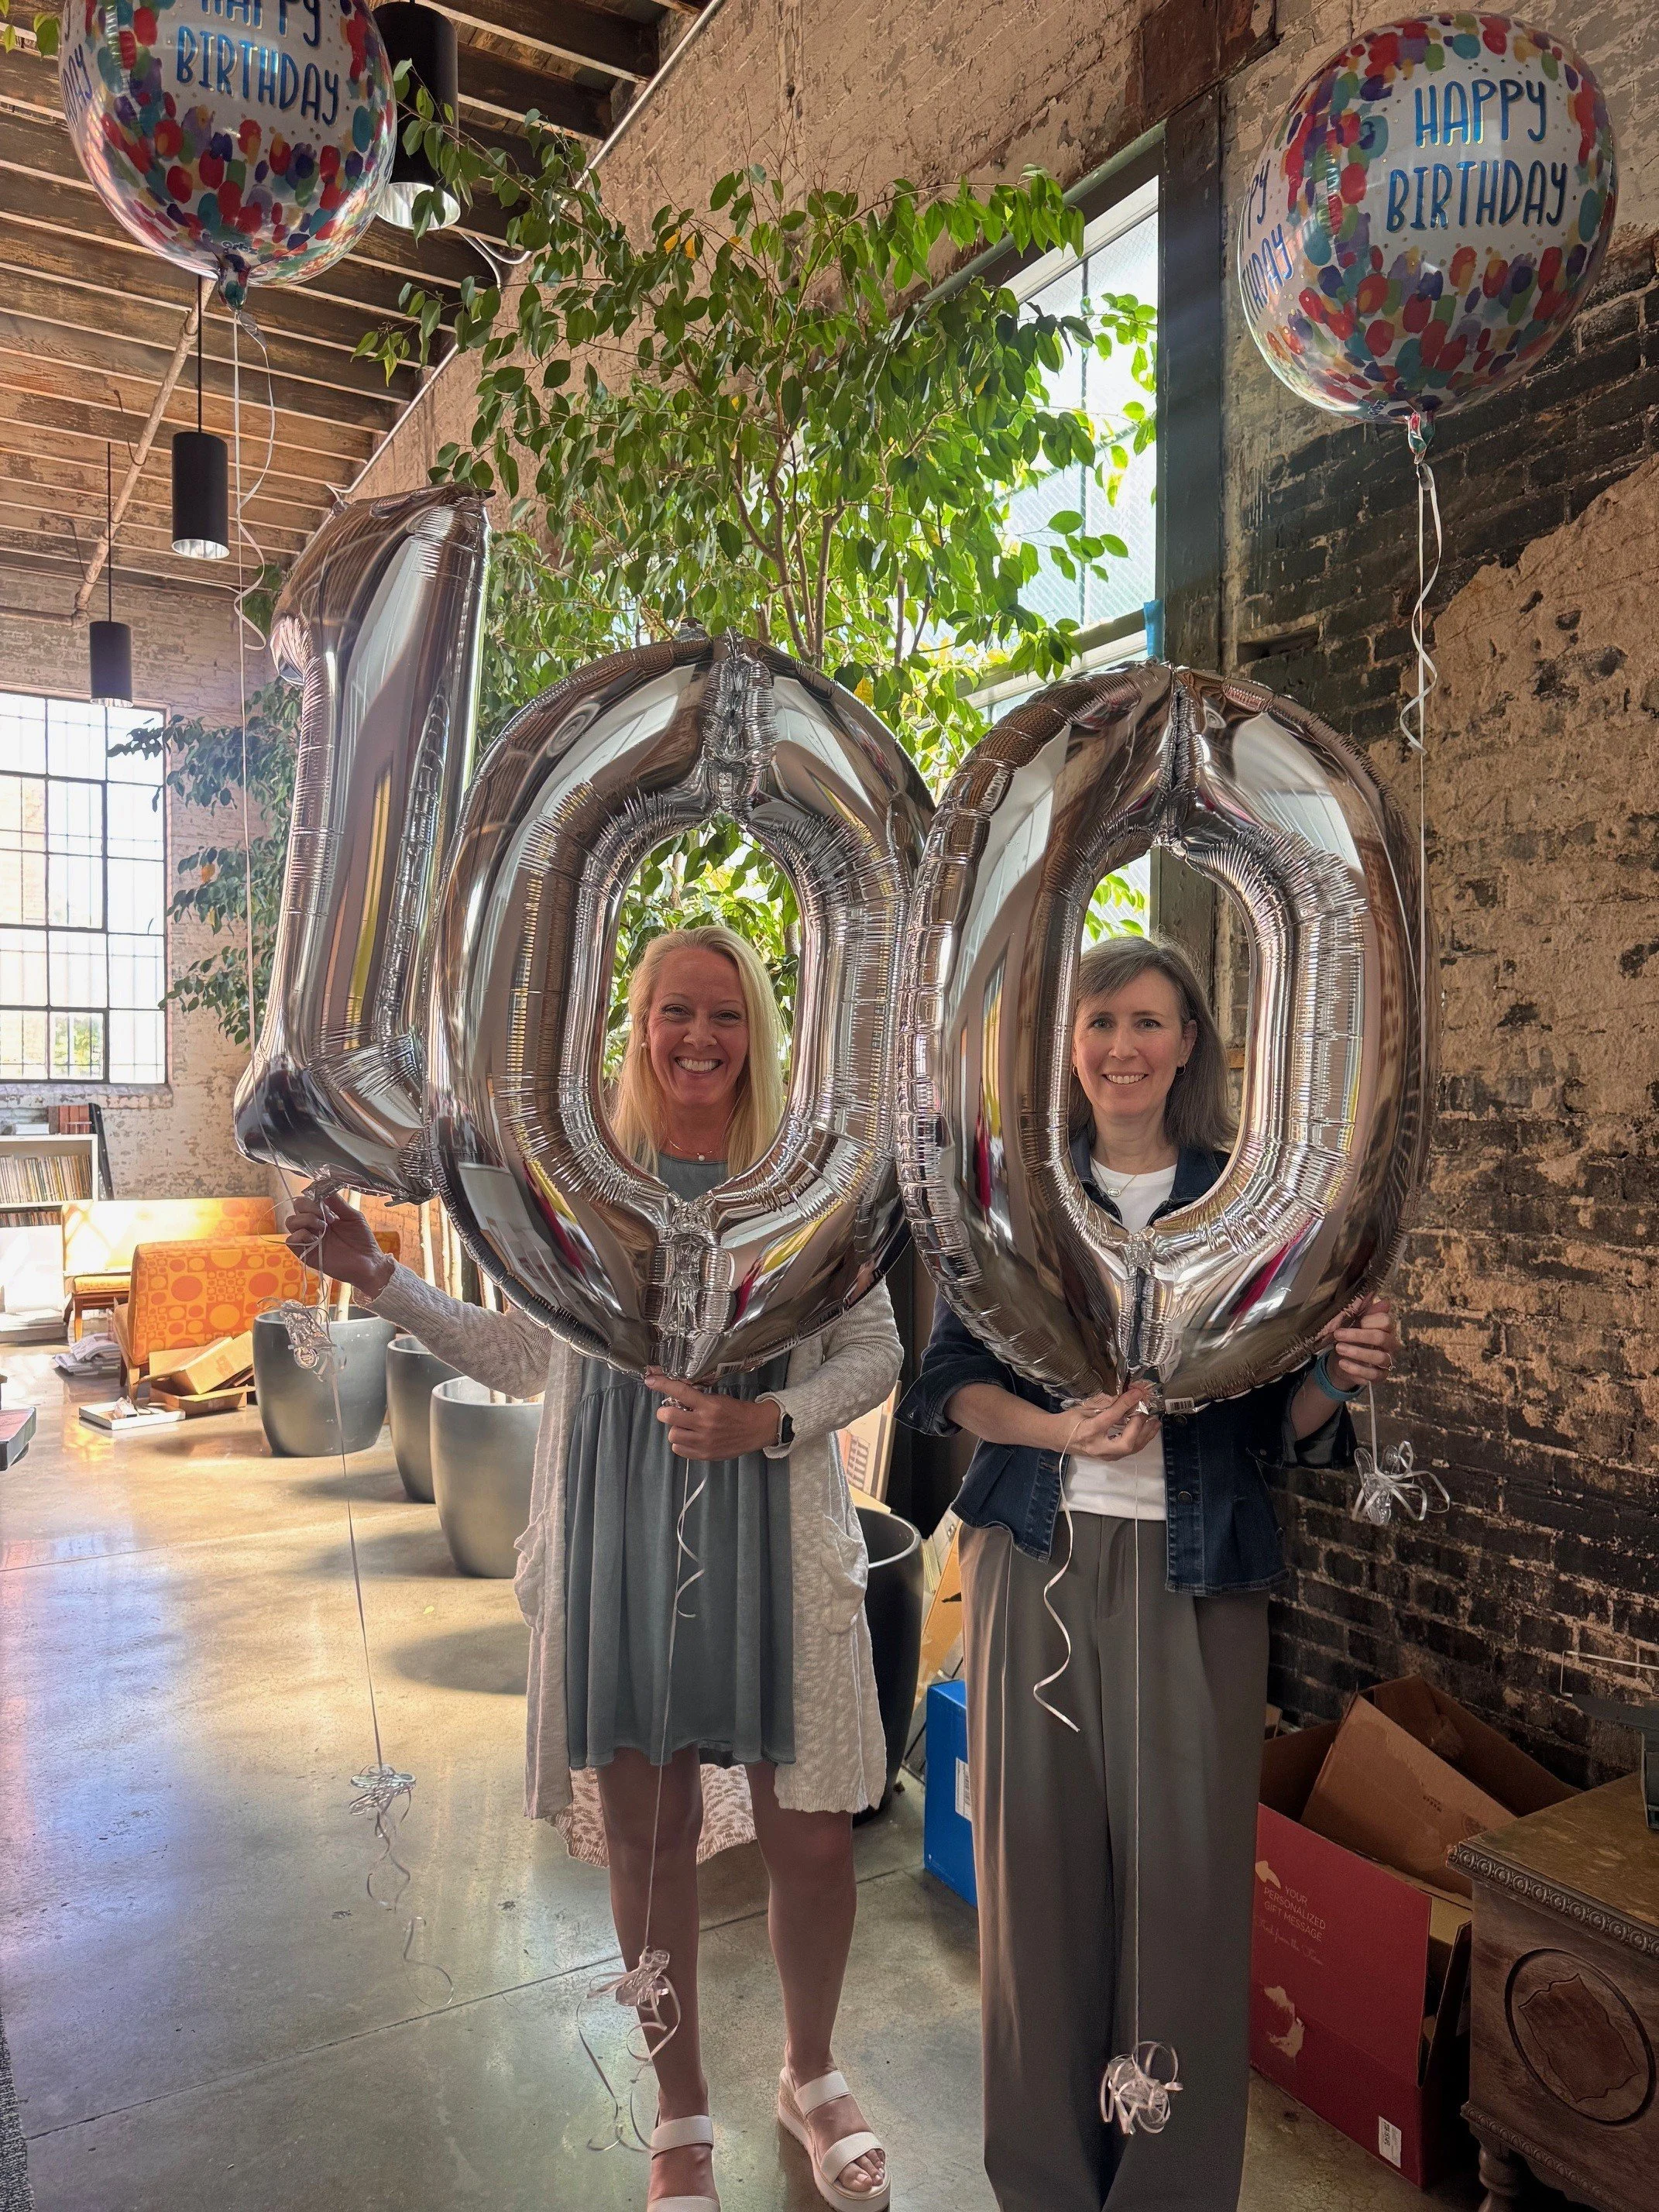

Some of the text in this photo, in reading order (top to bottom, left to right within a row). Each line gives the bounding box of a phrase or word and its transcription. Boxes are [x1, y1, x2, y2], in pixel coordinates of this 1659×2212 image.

[176, 25, 340, 125] BIRTHDAY
[1413, 78, 1549, 149] HAPPY
[1386, 160, 1568, 232] BIRTHDAY
[1264, 1887, 1326, 1929] PERSONALIZED
[1264, 1901, 1283, 1917] GIFT
[1283, 1912, 1324, 1942] MESSAGE
[1285, 1885, 1308, 1906] YOUR
